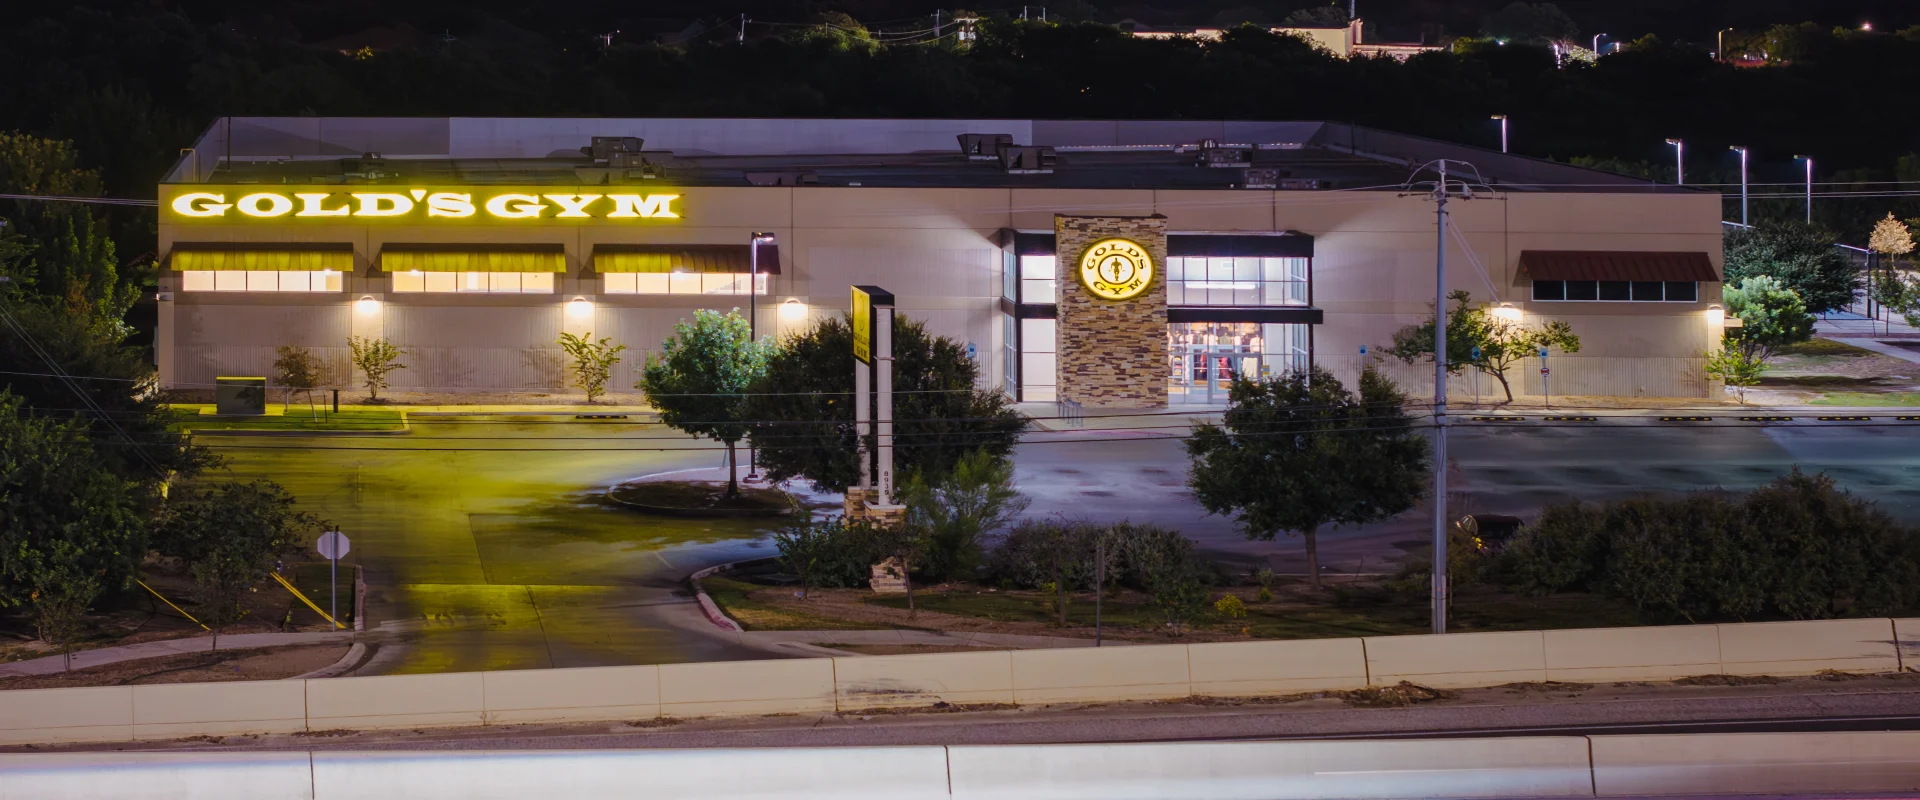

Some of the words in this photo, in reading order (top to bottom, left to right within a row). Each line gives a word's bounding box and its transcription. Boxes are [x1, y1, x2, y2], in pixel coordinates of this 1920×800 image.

[171, 189, 477, 218] GOLD'S
[485, 193, 683, 218] GYM
[1086, 244, 1146, 270] GOLD'S
[1093, 278, 1143, 295] GYM
